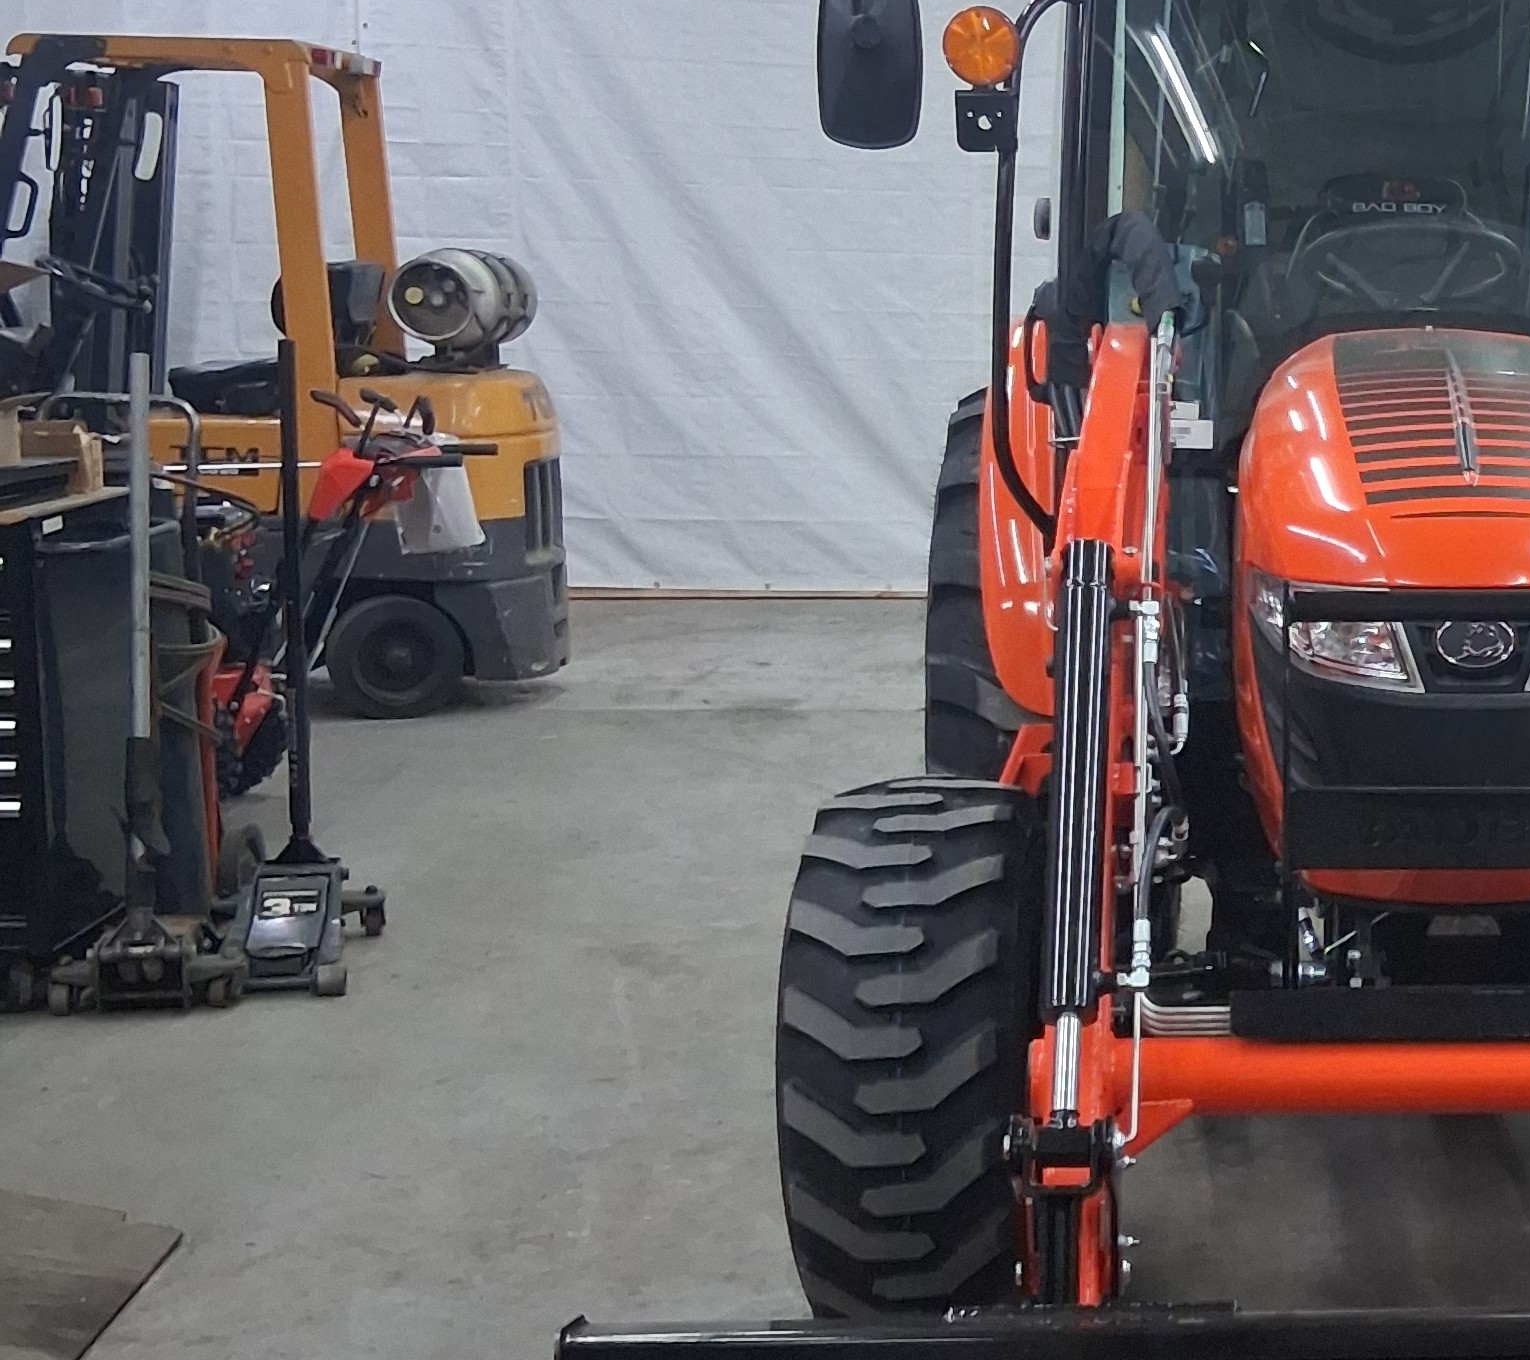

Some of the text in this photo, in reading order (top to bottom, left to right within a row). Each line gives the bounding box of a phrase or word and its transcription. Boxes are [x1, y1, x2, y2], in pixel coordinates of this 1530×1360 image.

[1352, 202, 1447, 214] BAD BOY
[262, 898, 291, 915] 3
